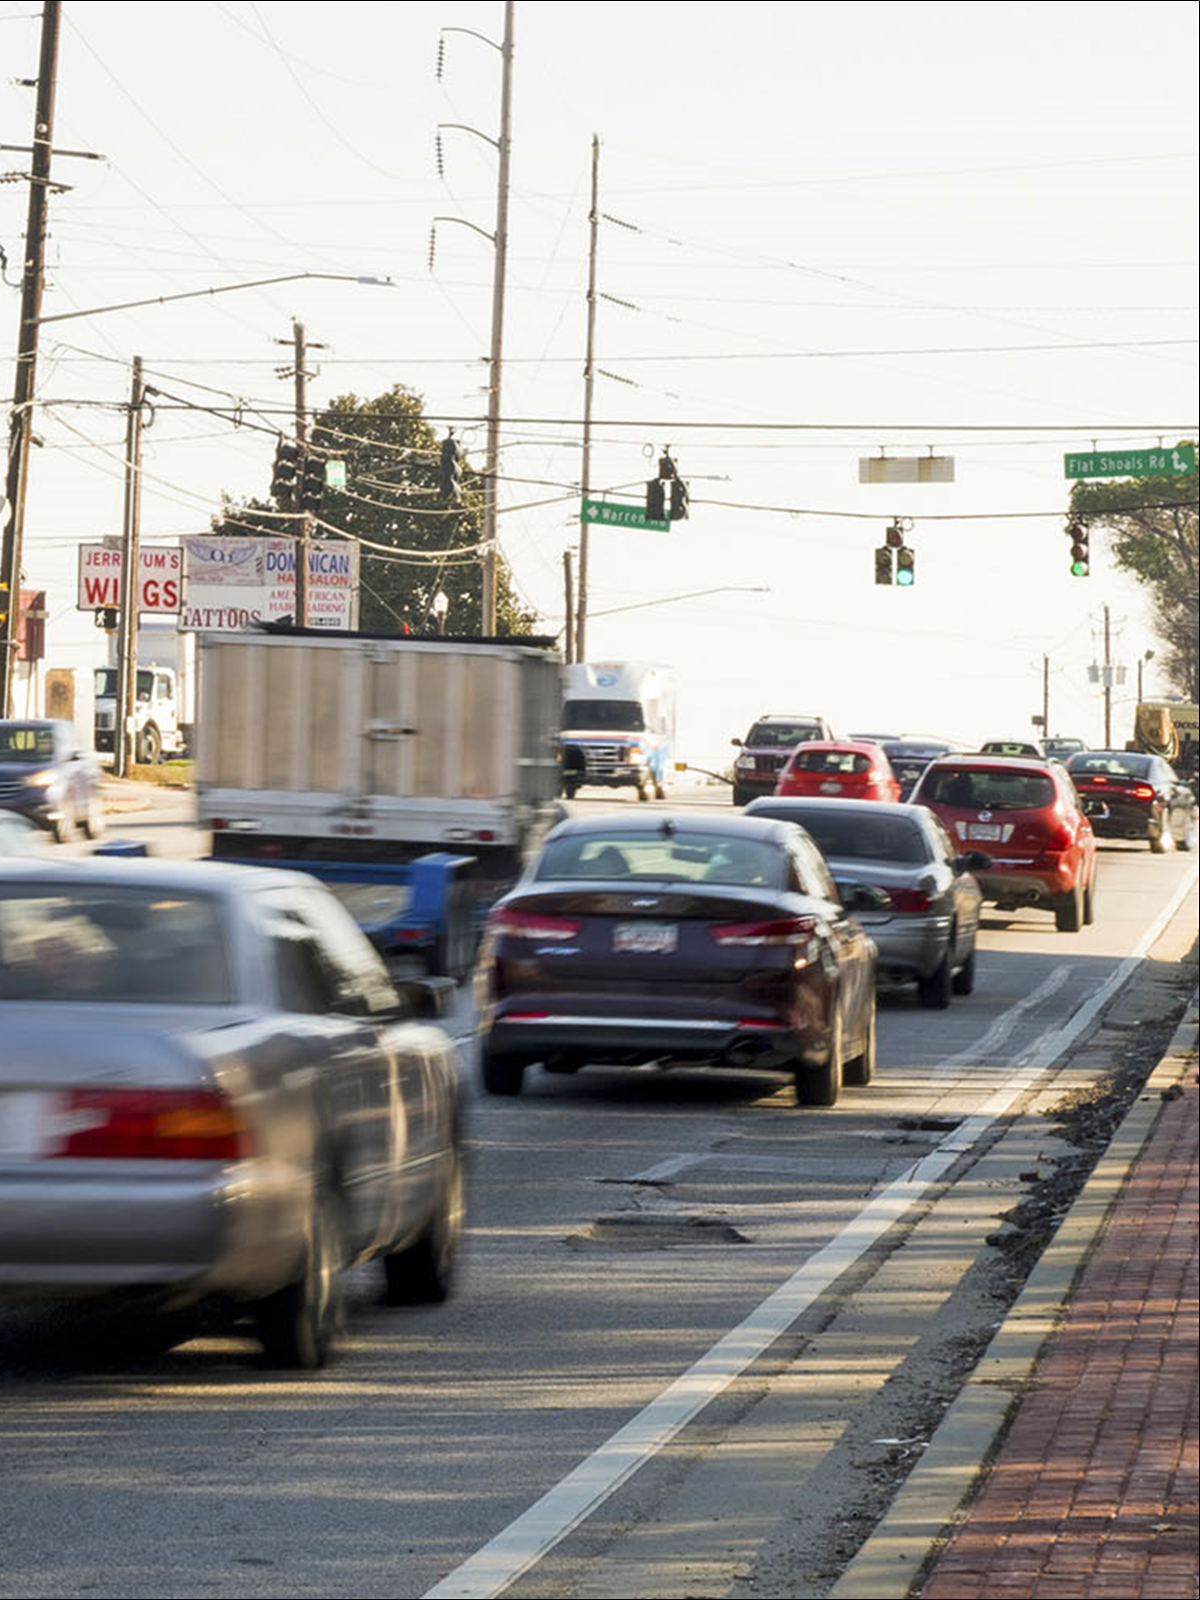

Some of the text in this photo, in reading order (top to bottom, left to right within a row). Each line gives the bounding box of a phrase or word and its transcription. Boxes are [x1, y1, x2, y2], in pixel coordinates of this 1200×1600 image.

[1068, 455, 1166, 473] Flat Shoals Rd
[602, 508, 646, 524] Warren
[85, 551, 179, 569] JERR UM'S
[309, 574, 349, 586] SALON
[84, 577, 178, 608] WIGS
[309, 591, 347, 602] FRICAN
